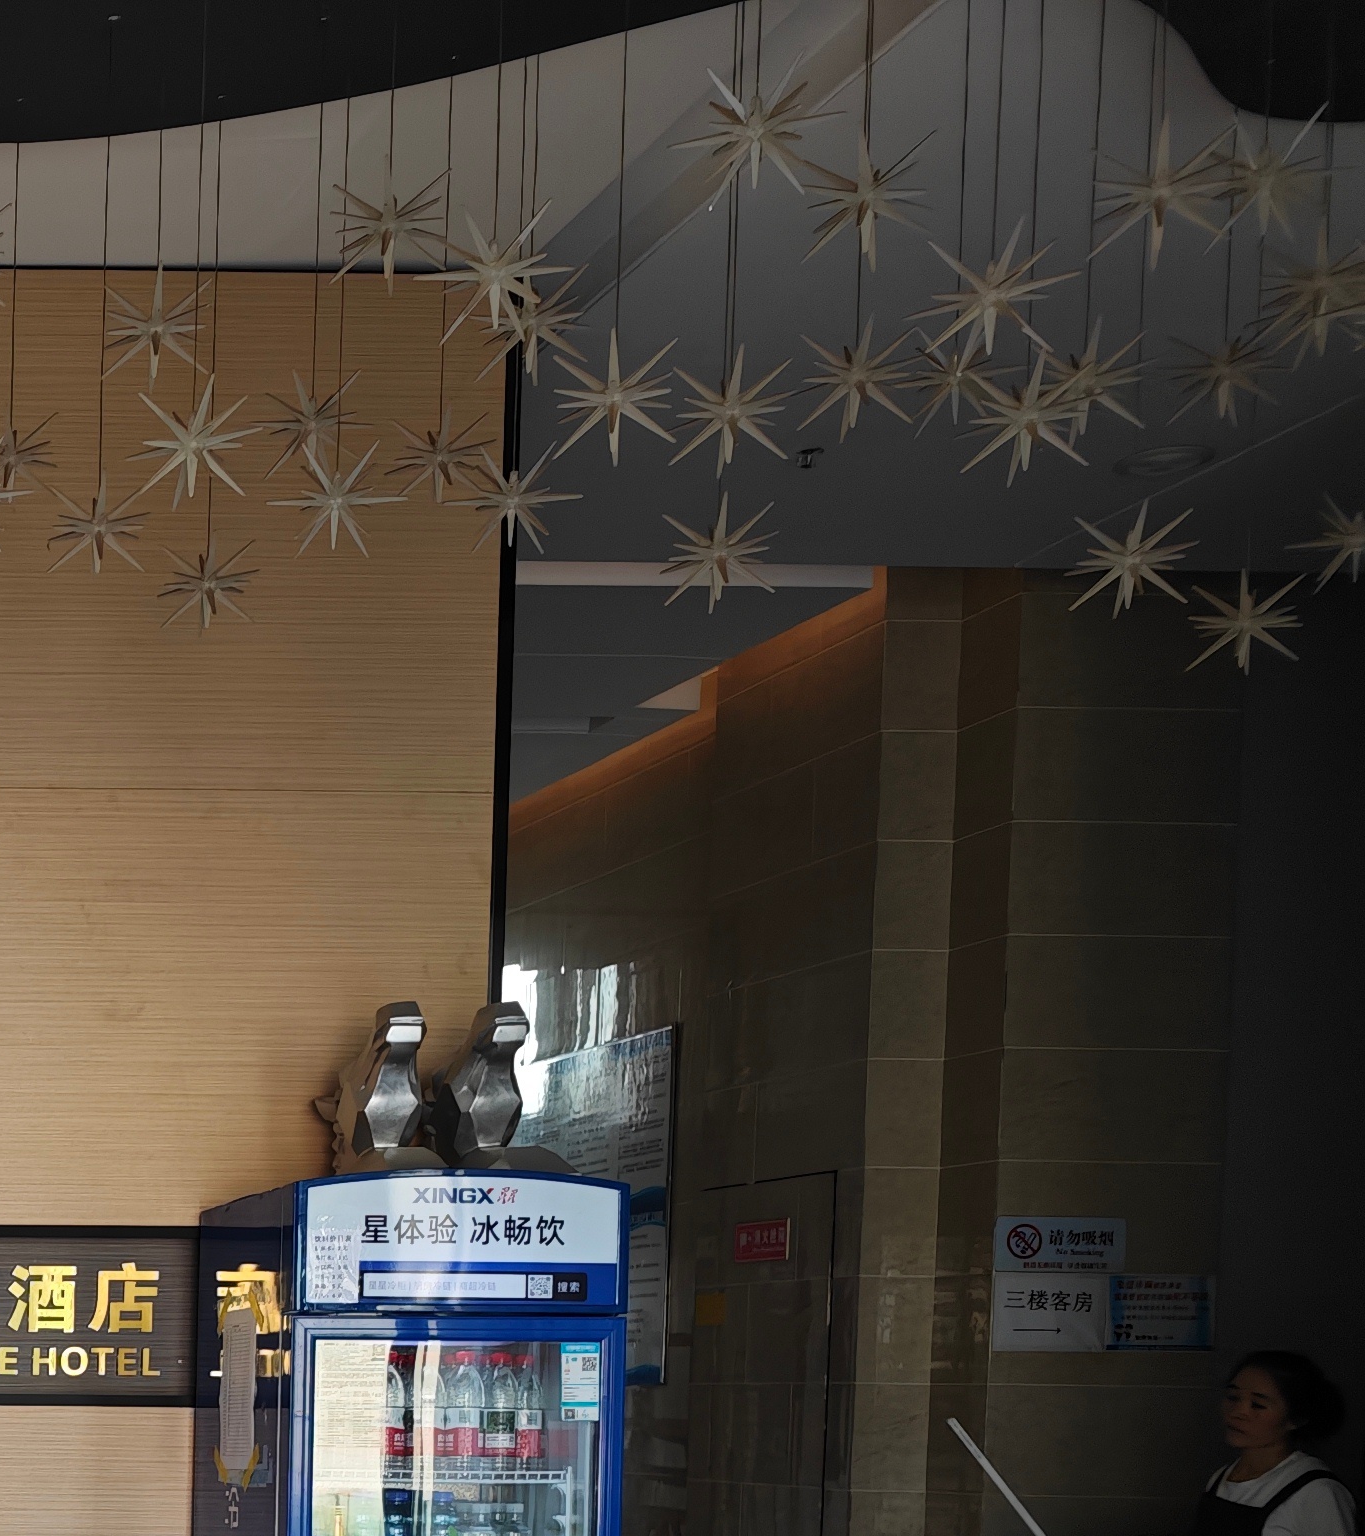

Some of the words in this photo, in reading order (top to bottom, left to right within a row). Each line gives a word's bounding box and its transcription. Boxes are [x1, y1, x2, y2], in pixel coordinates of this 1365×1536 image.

[413, 1187, 494, 1204] XINGX
[361, 1214, 458, 1245] 星体验
[469, 1216, 567, 1247] 冰畅饮
[1049, 1229, 1114, 1247] 请勿吸烟
[557, 1281, 580, 1293] 搜索
[1003, 1289, 1093, 1313] 三楼客房
[32, 1347, 161, 1377] HOTEL
